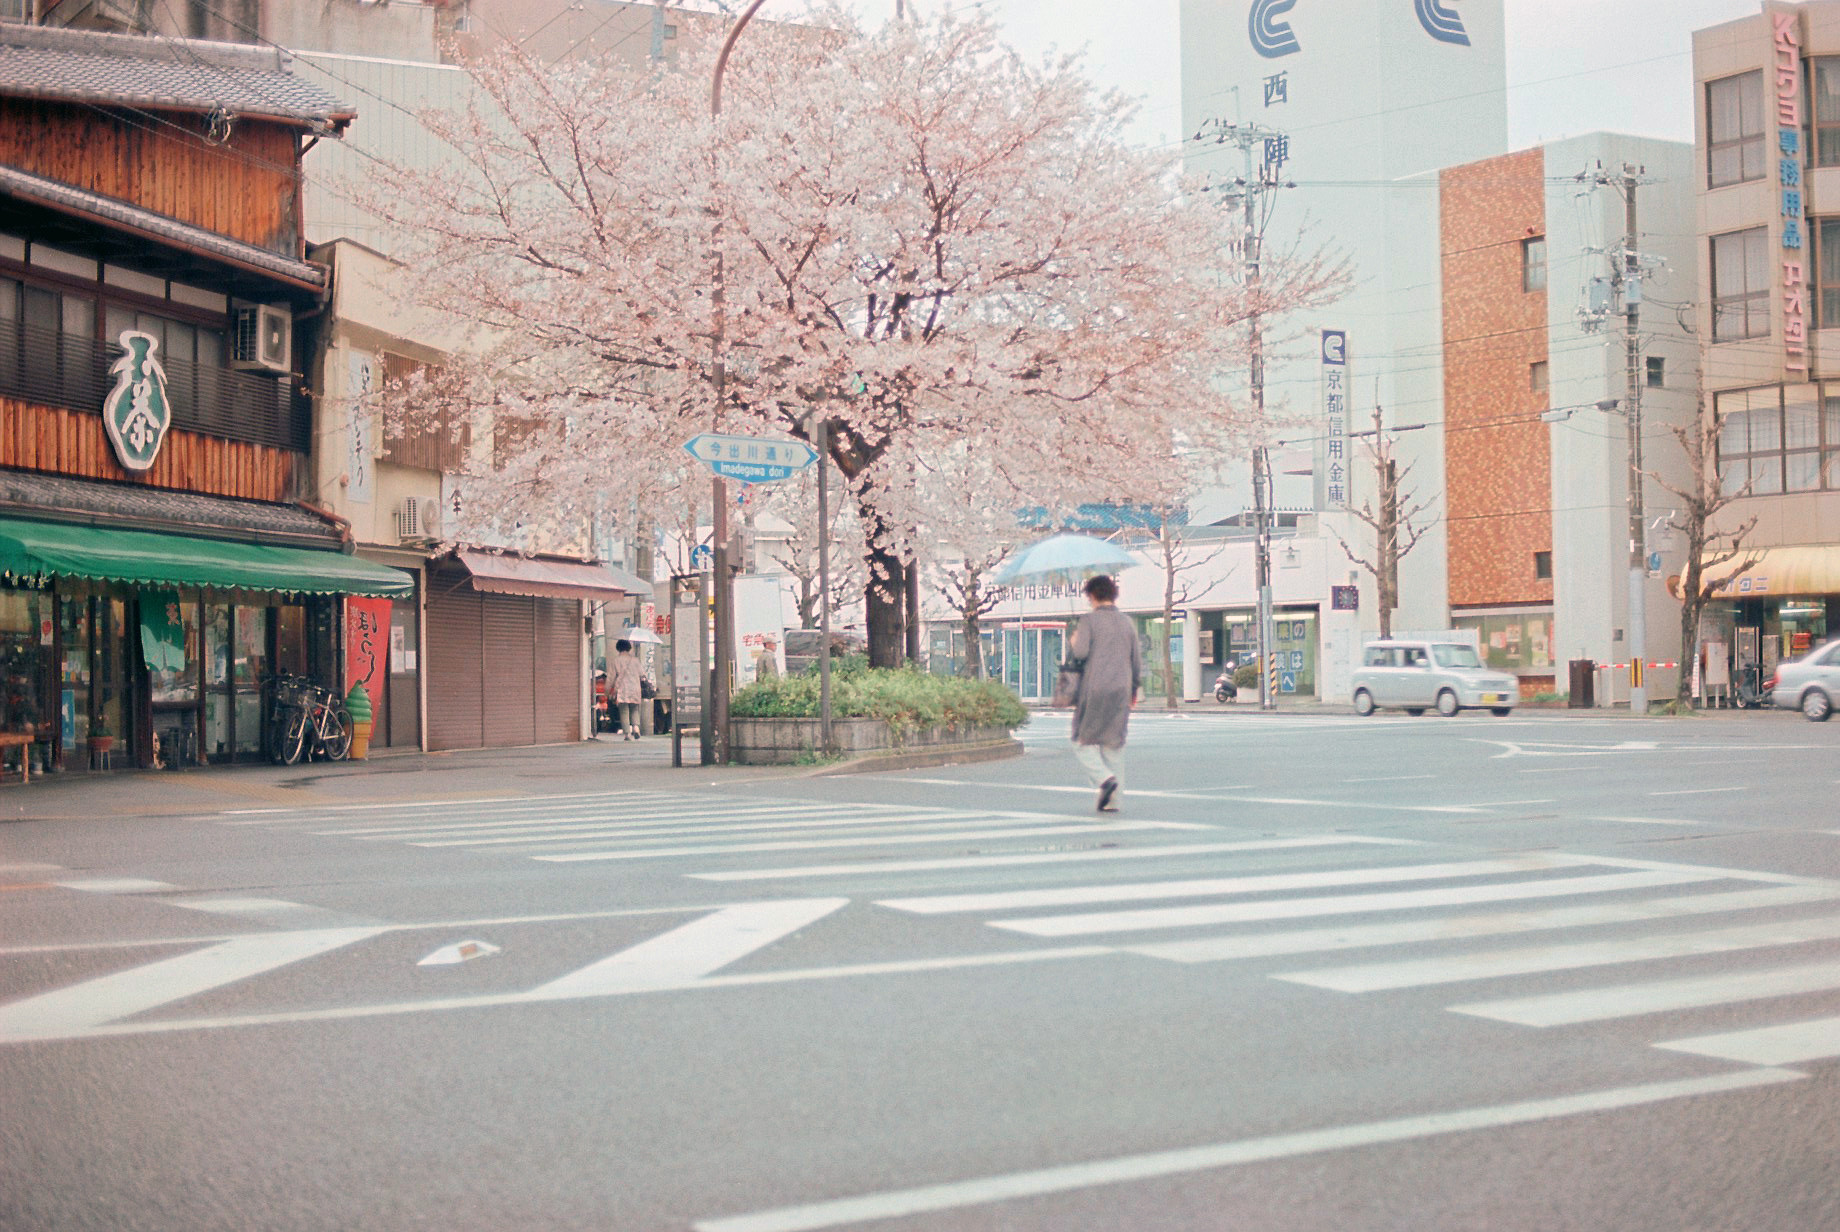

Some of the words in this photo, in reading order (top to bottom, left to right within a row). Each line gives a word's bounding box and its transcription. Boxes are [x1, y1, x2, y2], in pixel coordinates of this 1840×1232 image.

[1262, 69, 1290, 171] 西陣
[710, 441, 793, 462] 今出川通り
[1326, 369, 1345, 504] 京都信用金庫
[720, 463, 765, 477] Imadegawa
[768, 466, 785, 477] dori
